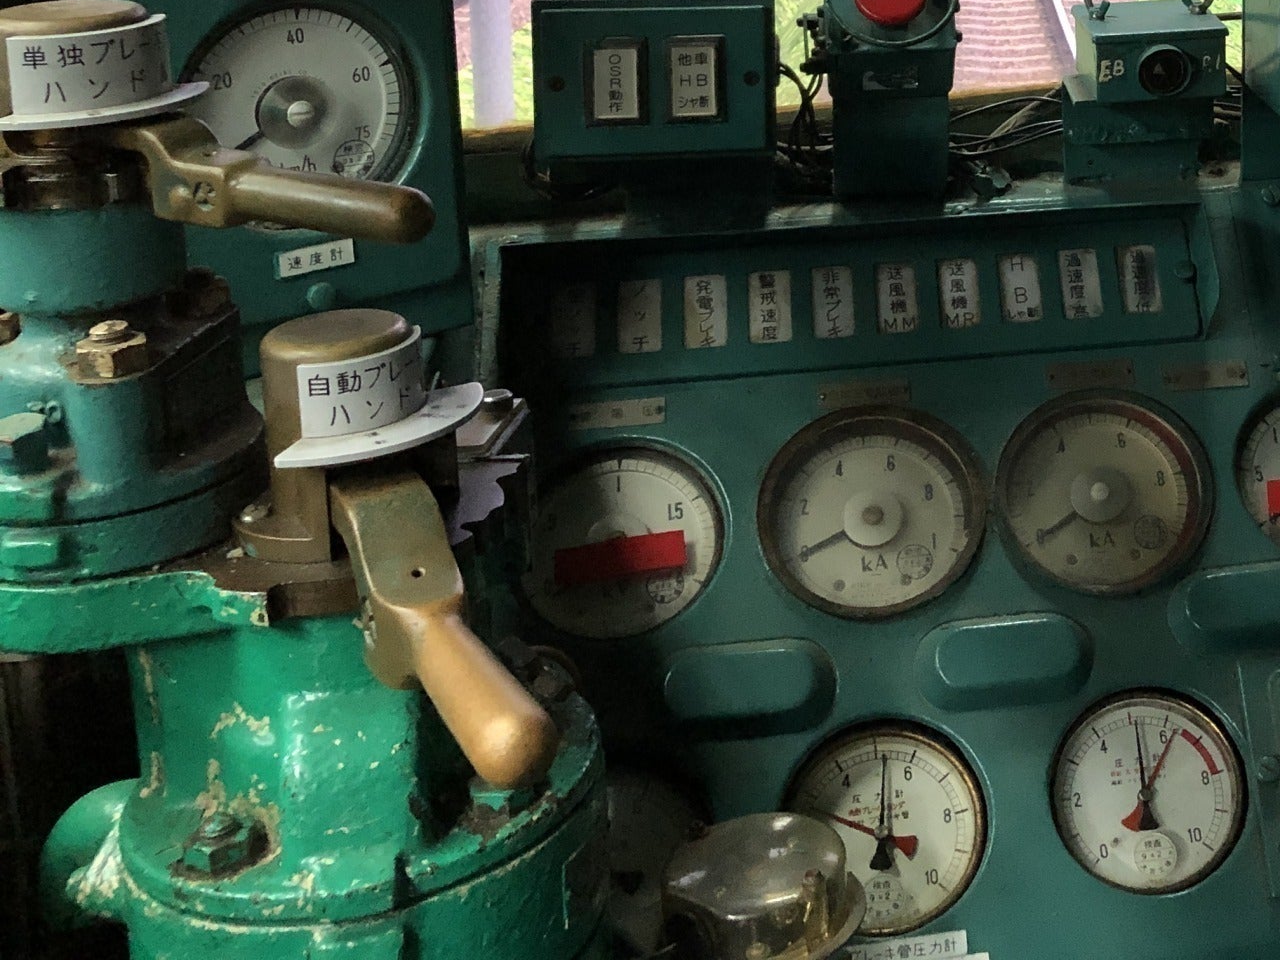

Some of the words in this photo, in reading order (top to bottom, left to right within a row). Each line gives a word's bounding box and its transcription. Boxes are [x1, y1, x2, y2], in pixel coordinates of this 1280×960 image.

[286, 27, 304, 45] 40
[678, 52, 708, 67] 他車
[351, 66, 370, 83] 60
[1099, 58, 1126, 83] EB
[212, 72, 232, 91] 20
[608, 53, 623, 114] OSR動作
[680, 73, 708, 88] HB
[287, 247, 344, 271] 速度計
[759, 273, 777, 340] 警戒速度
[1272, 426, 1279, 444] 1
[860, 553, 888, 573] kA
[1159, 730, 1168, 745] 6
[1099, 739, 1108, 754] 4
[903, 765, 913, 781] 6
[1201, 770, 1210, 786] 8
[841, 774, 851, 789] 4
[1073, 792, 1082, 808] 2
[943, 808, 952, 824] 8
[1187, 827, 1202, 843] 10
[1099, 844, 1109, 859] 0
[925, 868, 938, 886] 10
